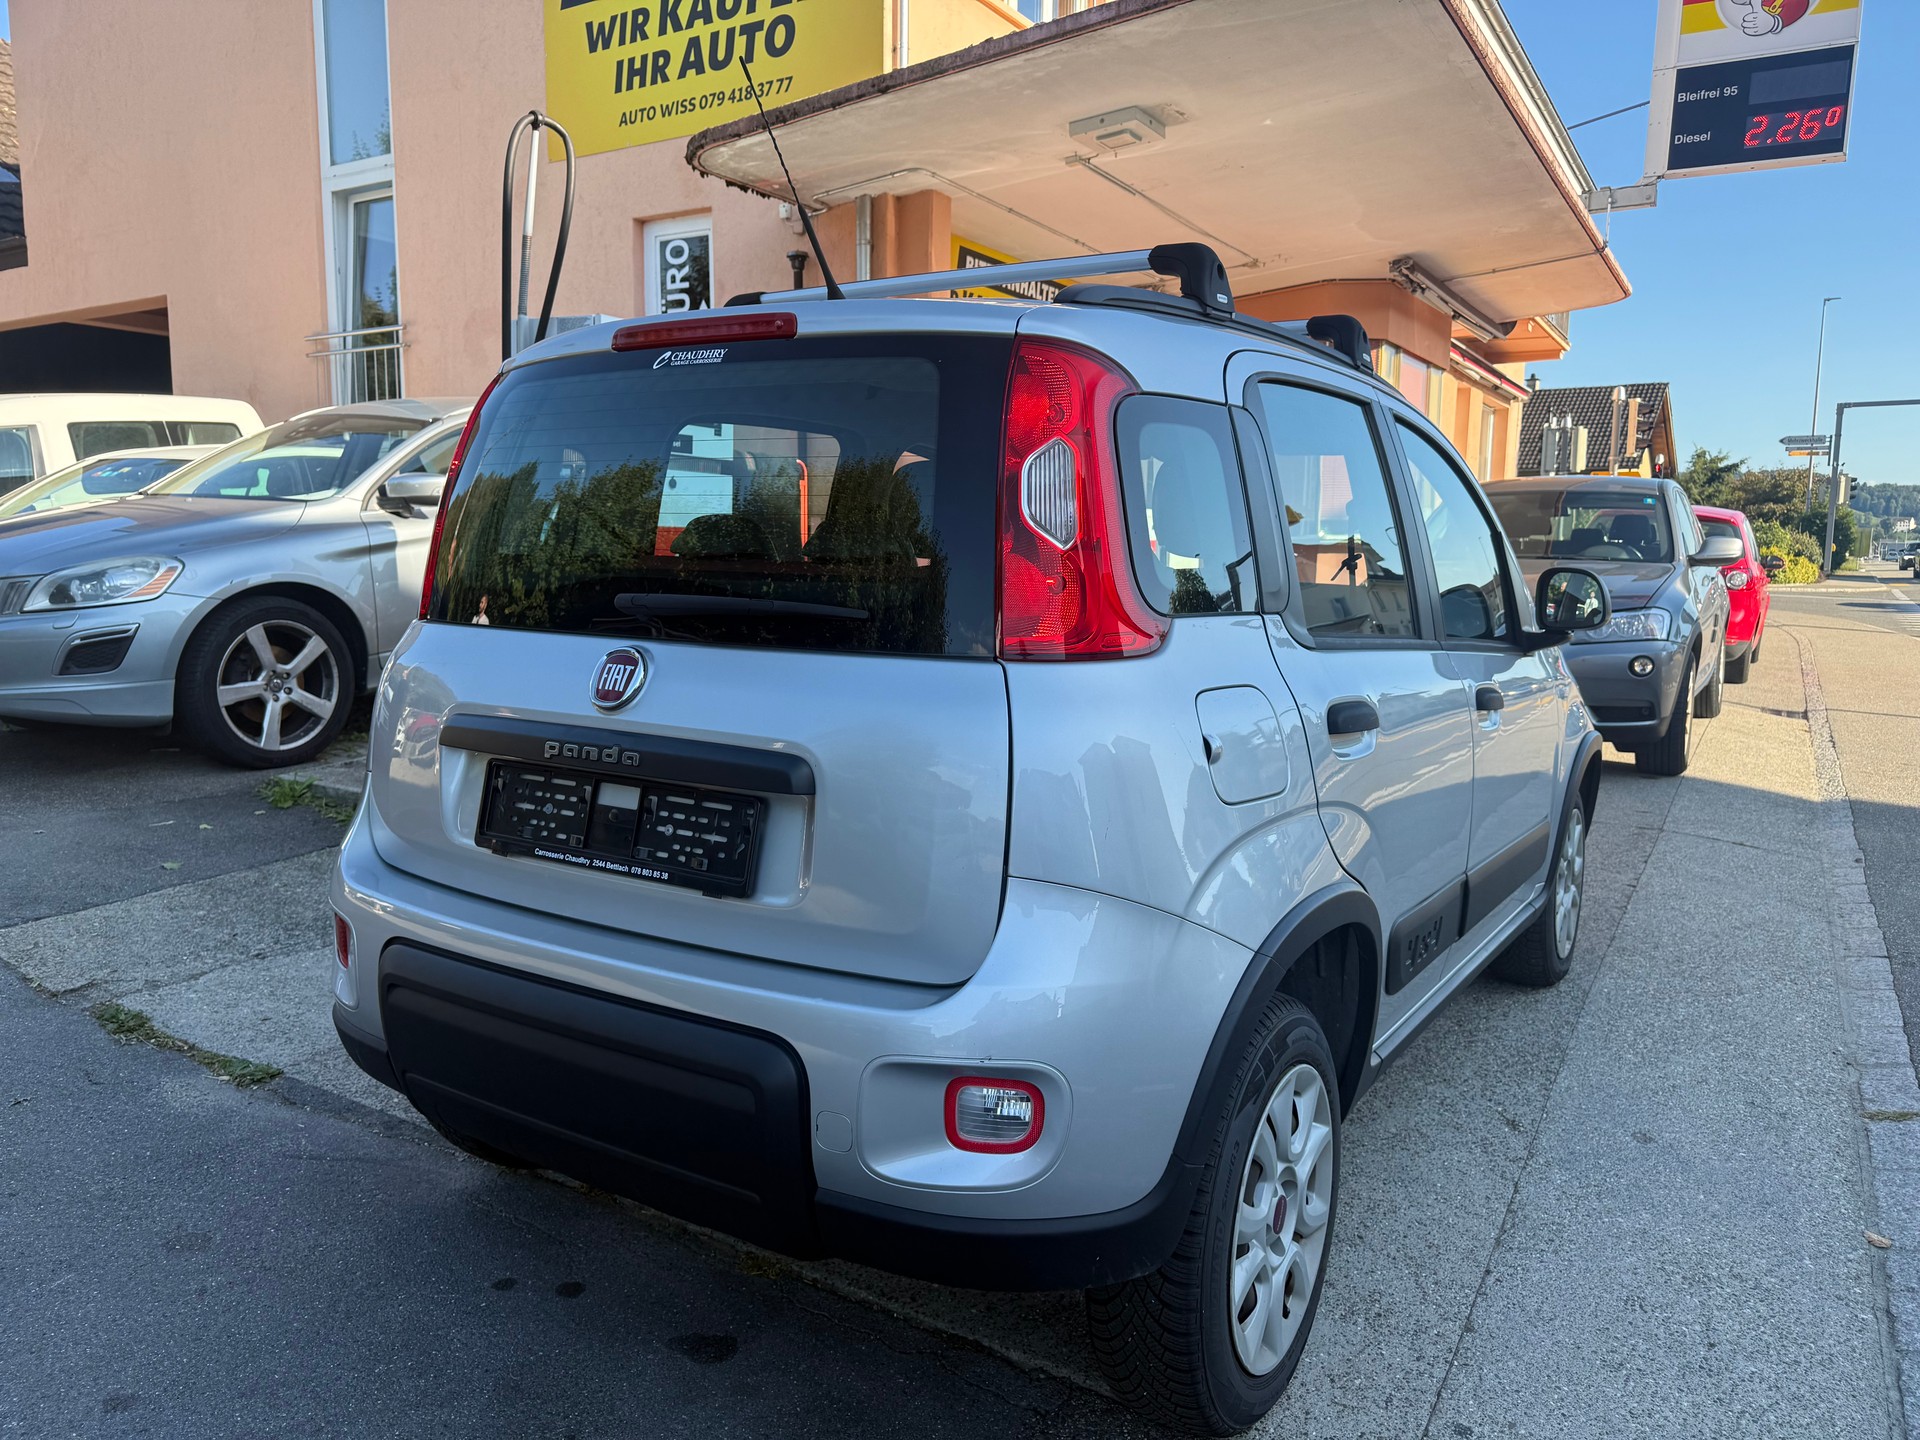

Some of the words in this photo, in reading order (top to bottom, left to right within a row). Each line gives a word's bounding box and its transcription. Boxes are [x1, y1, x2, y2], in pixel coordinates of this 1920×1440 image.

[584, 7, 650, 54] WIR
[614, 49, 672, 94] IHR
[677, 14, 797, 80] AUTO
[618, 106, 657, 127] AUTO
[660, 97, 697, 118] WISS
[699, 91, 726, 110] 079
[727, 85, 754, 104] 418
[1677, 88, 1721, 103] Bleifrei
[1723, 85, 1739, 97] 95
[1674, 131, 1711, 145] Diesel
[661, 239, 691, 314] ÜRO
[671, 348, 729, 361] CHAUDHRY
[598, 664, 635, 692] FIAT
[534, 848, 565, 860] Carrosserie
[564, 853, 591, 866] Chaudhry
[592, 859, 606, 868] 2544
[606, 862, 629, 873] Bettlach
[630, 866, 642, 875] 078
